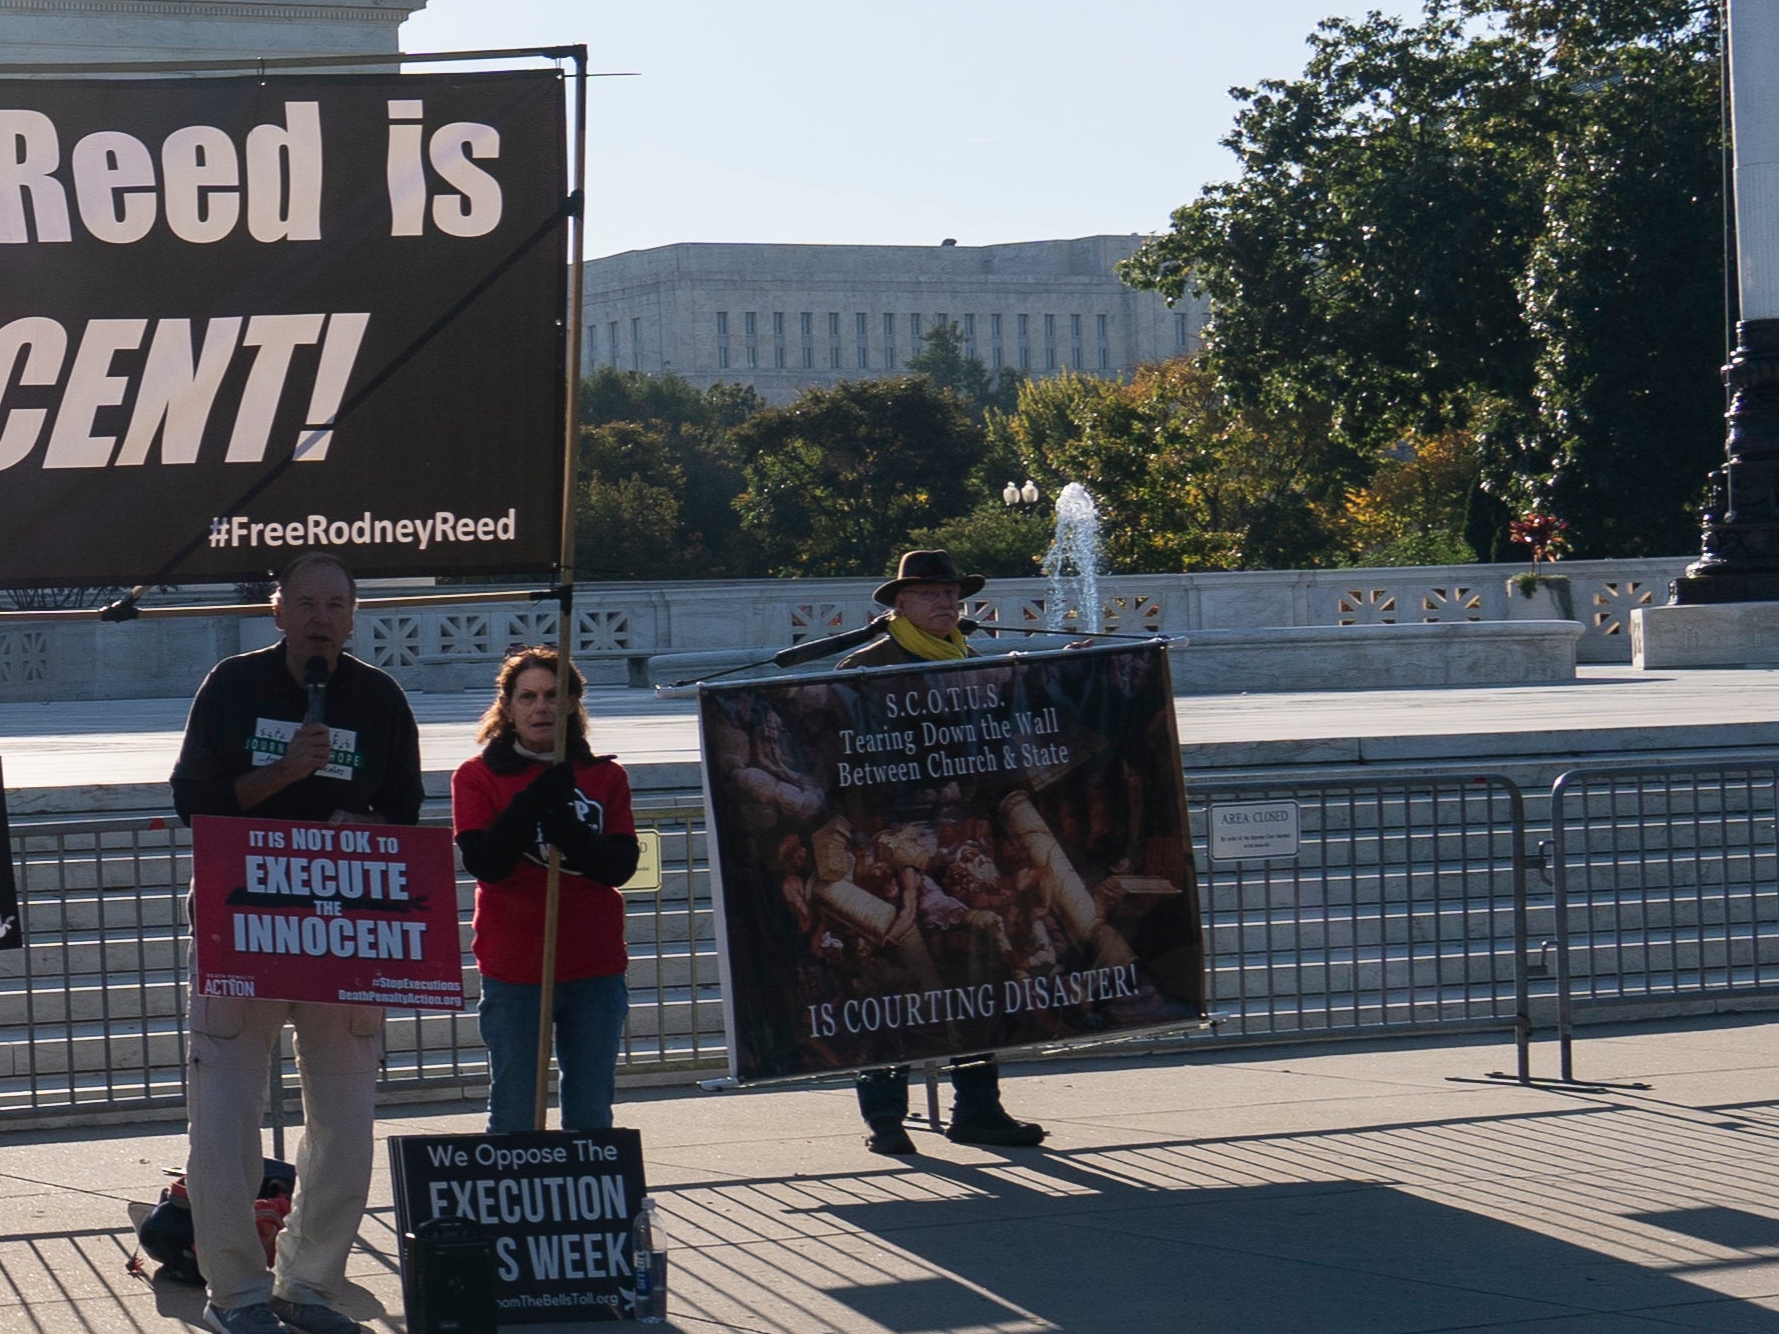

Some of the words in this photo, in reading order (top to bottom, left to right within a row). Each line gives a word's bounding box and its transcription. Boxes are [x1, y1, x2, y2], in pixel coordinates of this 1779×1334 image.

[388, 99, 503, 237] is
[208, 507, 516, 552] #FreeRodneyReed
[886, 683, 1006, 718] S.C.O.T.U.S.
[244, 737, 285, 754] JOURN
[839, 725, 916, 755] Tearing
[921, 722, 977, 747] Down
[981, 714, 1012, 740] the
[1015, 707, 1059, 736] Wall
[838, 763, 921, 787] Between
[927, 746, 998, 778] Church
[1003, 745, 1017, 770] &
[1021, 742, 1069, 768] State
[1221, 812, 1251, 825] AREA
[1253, 810, 1289, 823] CLOSED
[249, 830, 266, 847] IT
[268, 831, 286, 849] IS
[291, 828, 335, 852] NOT
[339, 830, 372, 854] OK
[377, 837, 399, 854] TO
[245, 855, 410, 901] EXECUTE
[313, 900, 343, 916] THE
[233, 913, 427, 961] INNOCENT
[204, 978, 255, 998] ACTION
[338, 989, 462, 1007] DeathPenaltyAction.org
[372, 976, 461, 991] #StopExecutions
[807, 1002, 836, 1039] IS
[843, 983, 995, 1033] COURTING
[1003, 963, 1139, 1014] DISASTER!
[427, 1145, 469, 1167] We
[475, 1143, 568, 1170] Oppose
[572, 1139, 618, 1162] The
[429, 1174, 628, 1225] EXECUTION
[526, 1232, 633, 1280] WEEK
